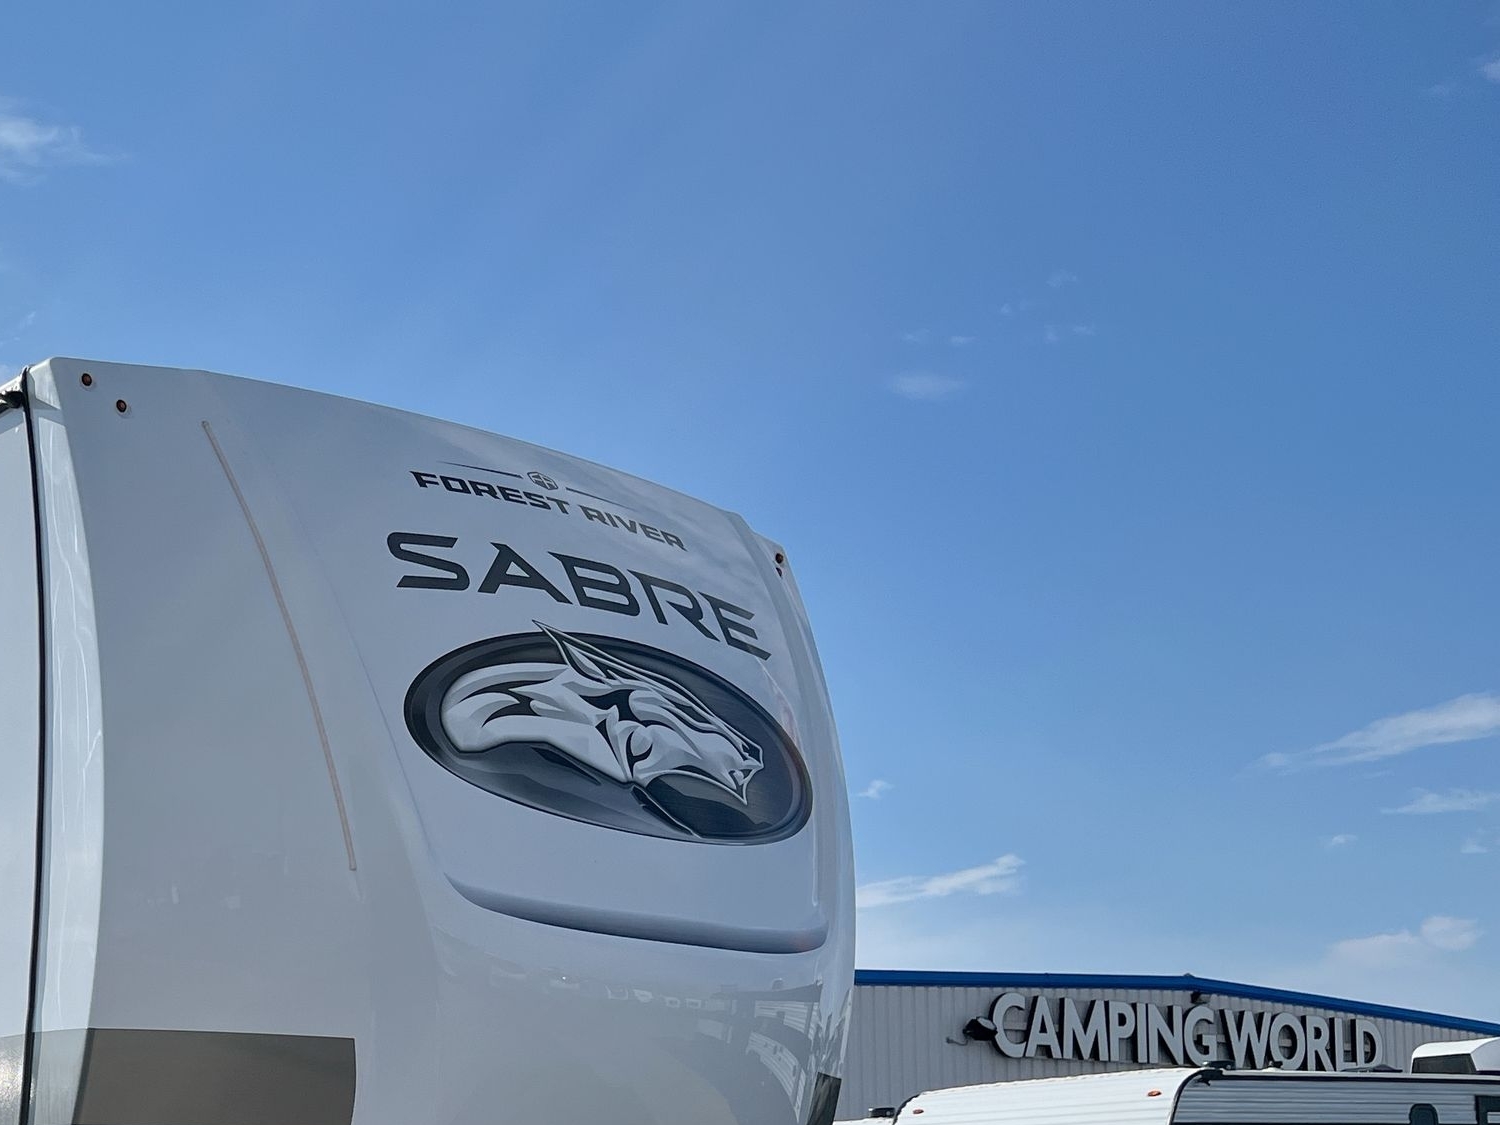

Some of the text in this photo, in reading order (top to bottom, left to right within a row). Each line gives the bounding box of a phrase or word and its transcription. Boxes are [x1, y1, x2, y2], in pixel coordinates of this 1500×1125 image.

[409, 471, 687, 551] FOREST RIVER
[387, 532, 771, 660] SABRE
[990, 992, 1383, 1071] CAMPING WORLD
